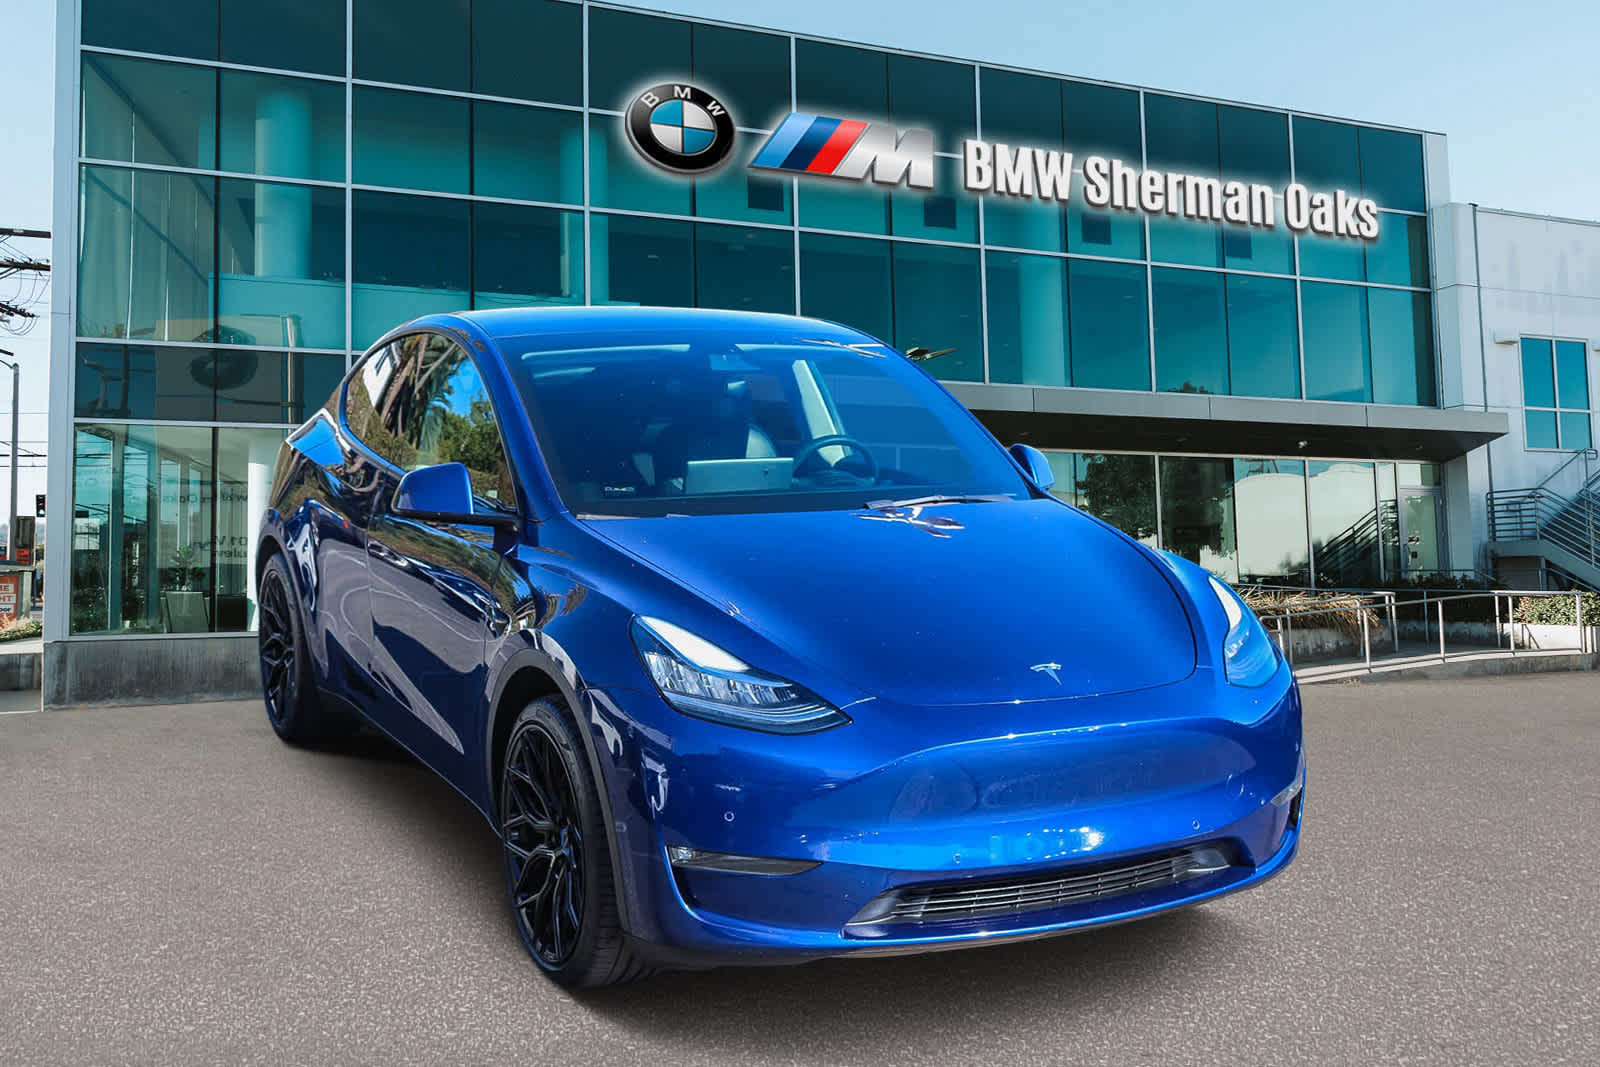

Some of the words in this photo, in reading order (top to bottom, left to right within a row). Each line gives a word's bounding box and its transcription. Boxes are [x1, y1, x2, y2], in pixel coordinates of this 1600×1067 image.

[640, 84, 726, 117] BMW
[963, 138, 1073, 201] BMW
[1083, 155, 1275, 228] Sherman
[1283, 182, 1380, 241] Oaks
